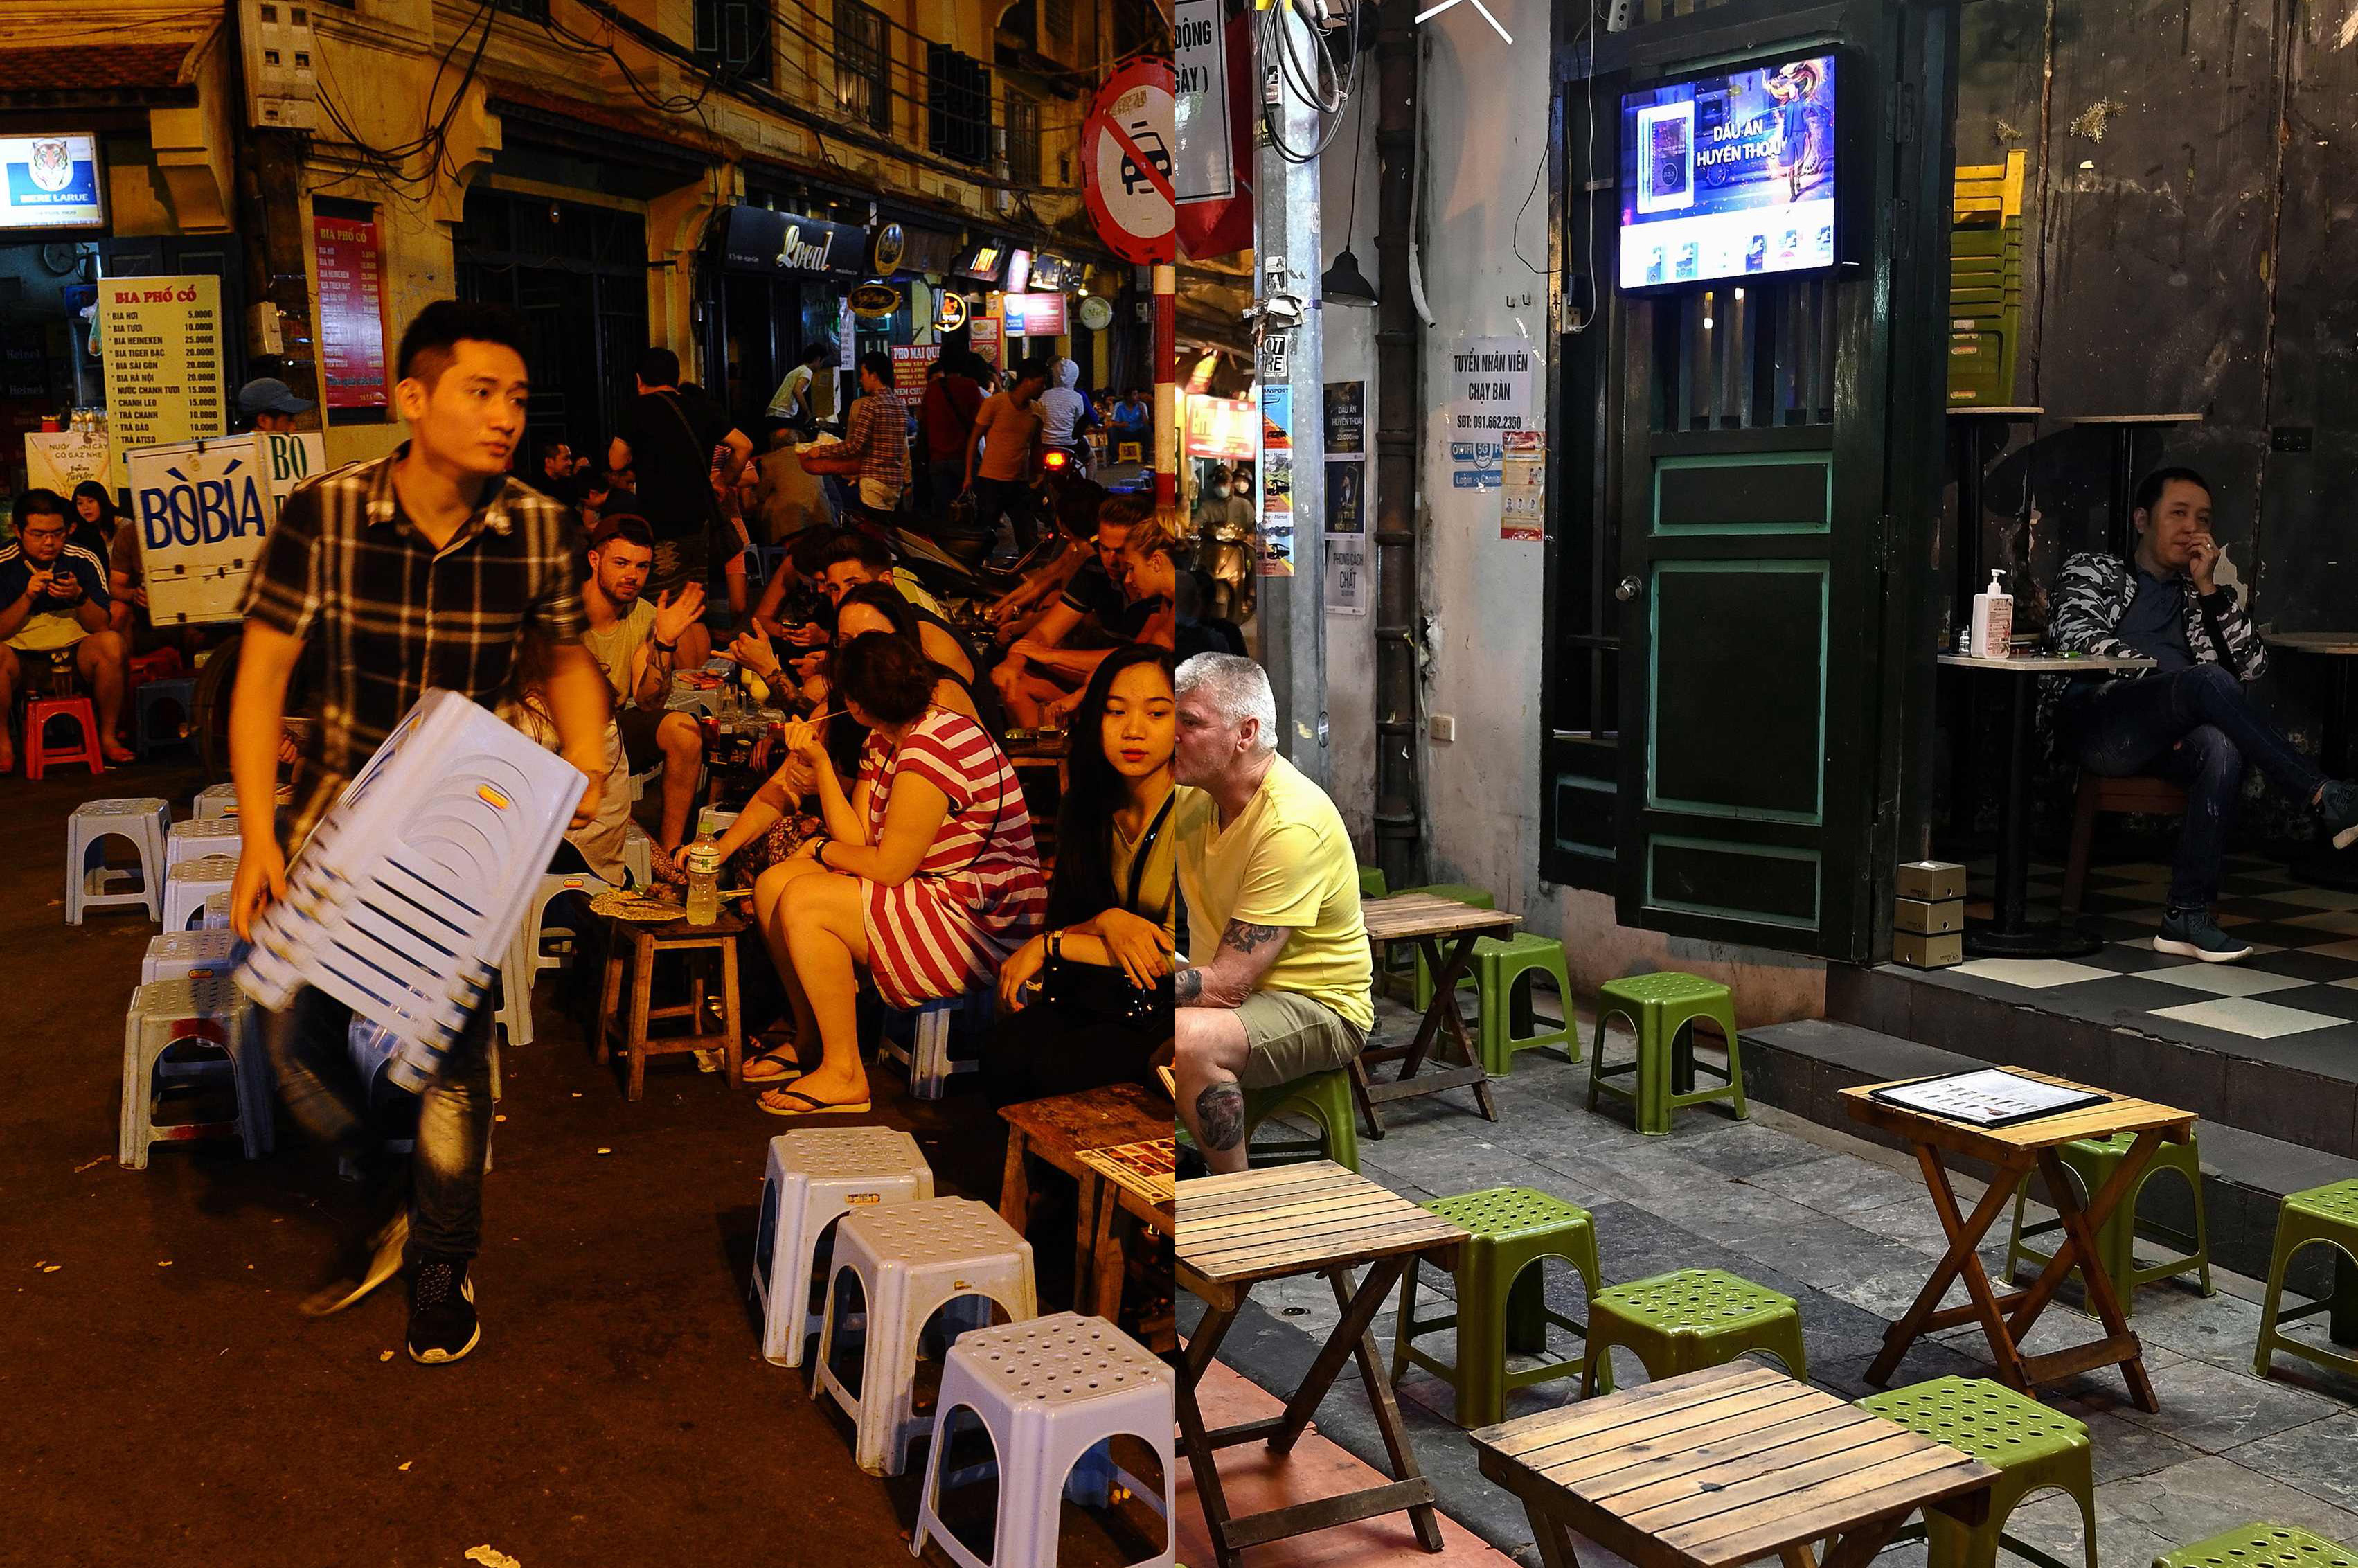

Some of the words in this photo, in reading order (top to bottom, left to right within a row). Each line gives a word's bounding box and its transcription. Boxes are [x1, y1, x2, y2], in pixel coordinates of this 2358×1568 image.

[53, 193, 89, 202] LARUE
[321, 228, 335, 240] BIA
[115, 292, 141, 303] BIA
[143, 285, 173, 303] PHỐ
[177, 284, 197, 302] CỔ
[127, 337, 163, 345] HEINEKEN
[129, 349, 148, 357] TIGER
[1454, 347, 1479, 373] TUYỂN
[1482, 350, 1506, 372] NHÂN
[1508, 350, 1528, 372] VIÊN
[1468, 382, 1490, 404] CHẠY
[1492, 379, 1510, 400] BÀN
[118, 399, 142, 407] CHANH
[1481, 474, 1502, 484] Conne
